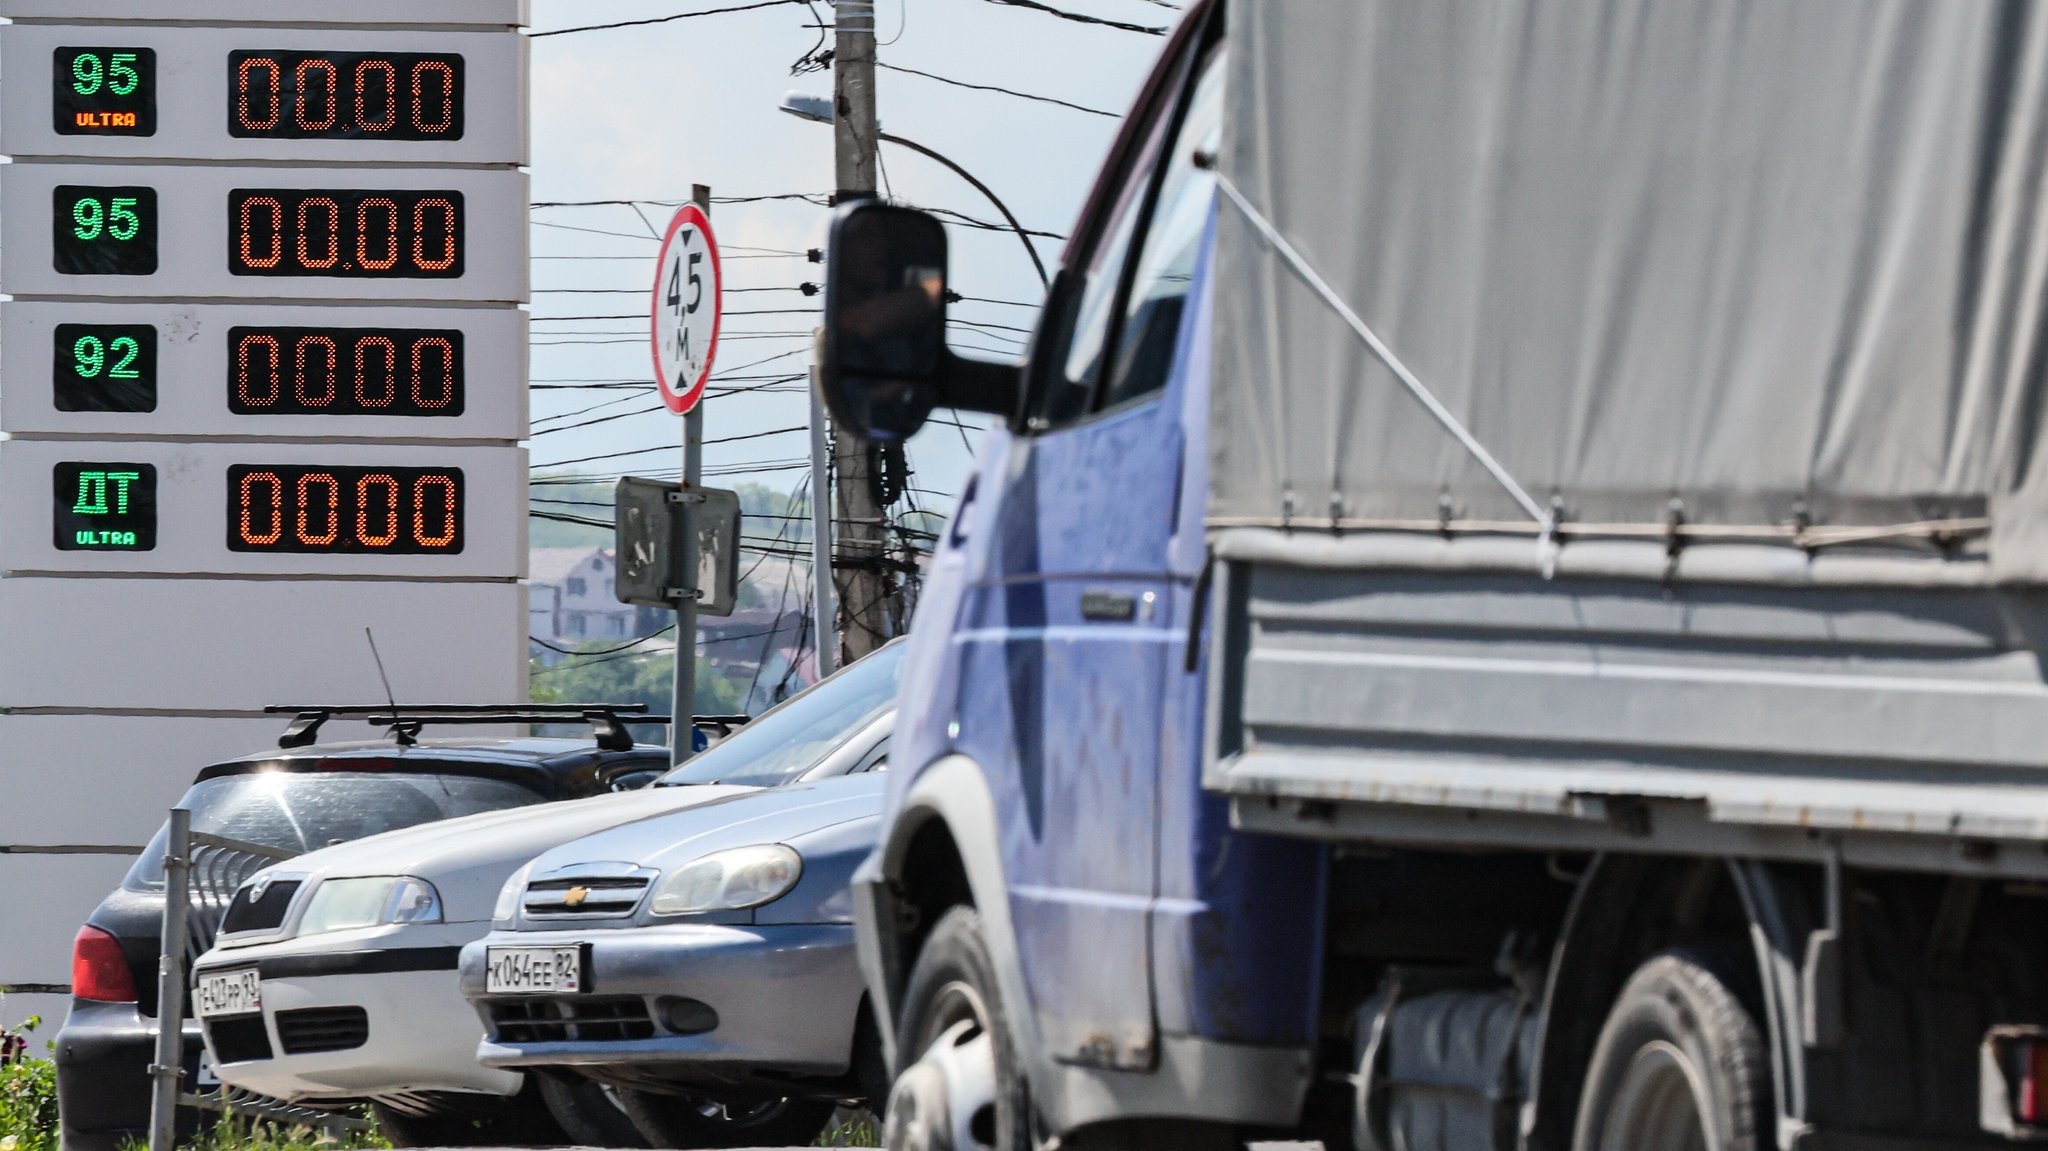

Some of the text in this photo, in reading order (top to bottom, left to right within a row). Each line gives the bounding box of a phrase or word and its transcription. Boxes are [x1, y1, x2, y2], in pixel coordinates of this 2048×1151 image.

[73, 53, 138, 95] 95
[76, 111, 136, 128] ULTRA
[73, 198, 139, 241] 95
[240, 197, 455, 270] 00.00
[667, 252, 702, 327] 4,5
[74, 336, 139, 378] 92
[73, 472, 139, 514] ДТ
[76, 531, 136, 545] ULTRA
